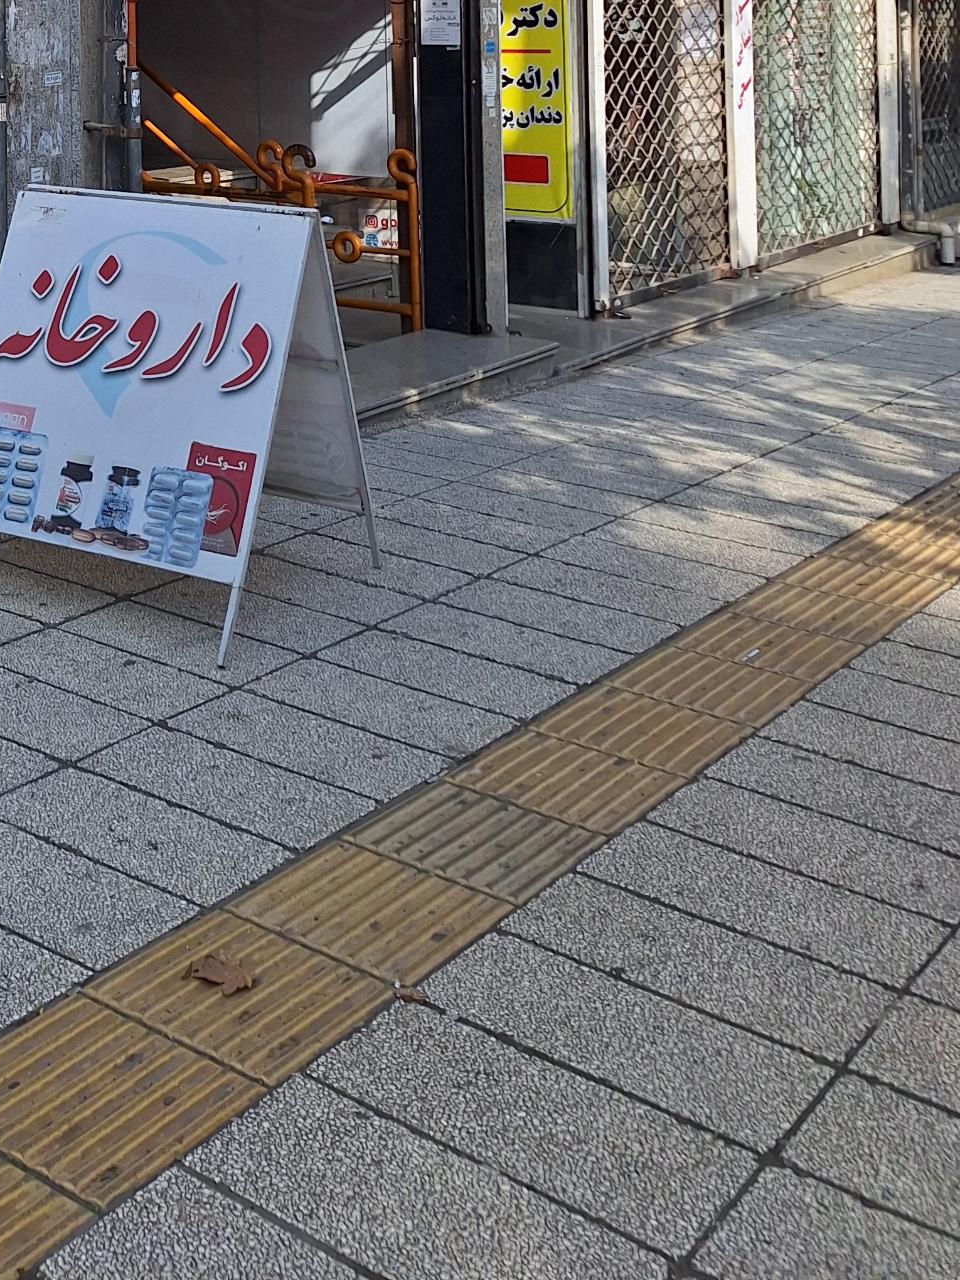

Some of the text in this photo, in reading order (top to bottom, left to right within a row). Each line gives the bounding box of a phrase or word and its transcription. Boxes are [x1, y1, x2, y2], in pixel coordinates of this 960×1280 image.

[506, 2, 558, 36] دکتر
[517, 65, 559, 98] ارائه
[516, 105, 563, 129] دندان
[195, 453, 248, 473] اکوگان
